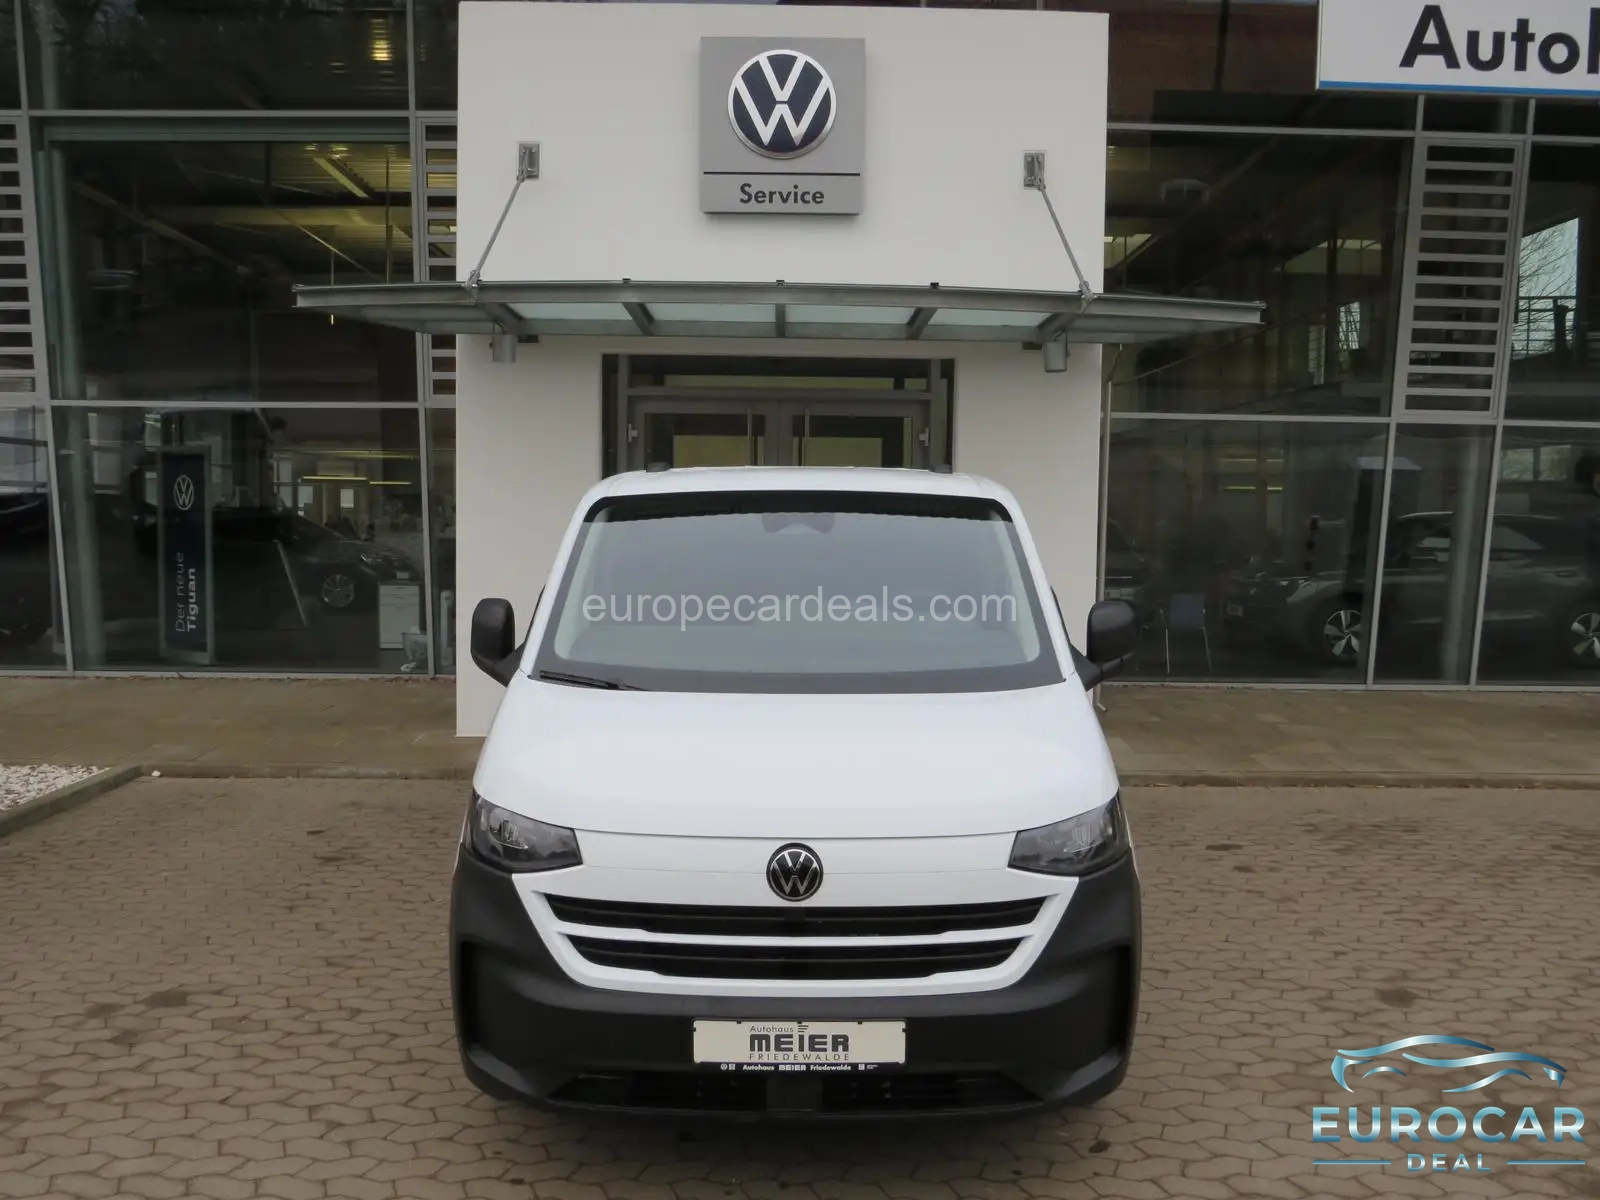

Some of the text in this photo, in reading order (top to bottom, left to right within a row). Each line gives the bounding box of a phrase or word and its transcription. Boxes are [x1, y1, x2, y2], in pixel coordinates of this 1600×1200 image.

[739, 182, 825, 205] Service
[176, 552, 186, 632] Der neue
[187, 568, 199, 632] Tiguan
[749, 1025, 794, 1033] Autohaus
[749, 1033, 849, 1052] MEIER
[749, 1053, 849, 1061] FRIEDEWALDE
